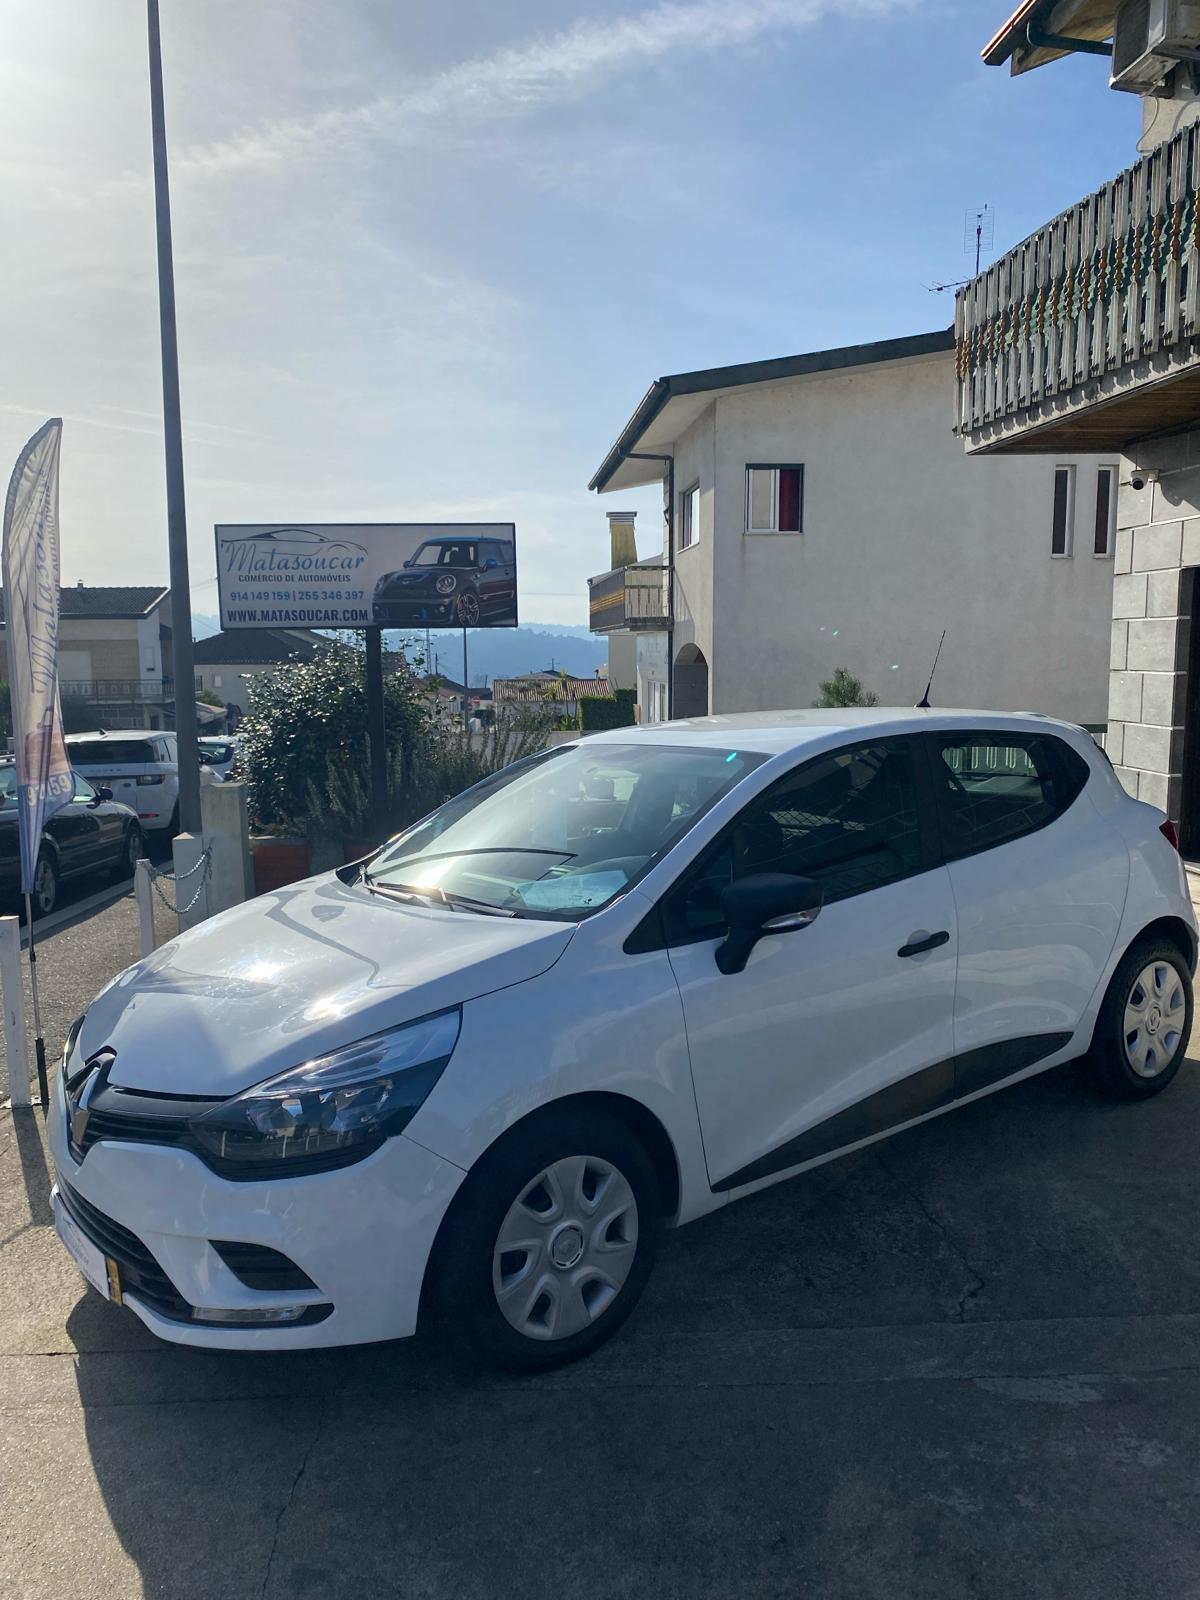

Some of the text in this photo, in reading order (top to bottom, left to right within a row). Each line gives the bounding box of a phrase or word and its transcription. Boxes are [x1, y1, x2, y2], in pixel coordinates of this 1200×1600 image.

[222, 543, 365, 574] Matasoucar
[31, 470, 58, 694] Matasou
[238, 573, 352, 583] COMÉRCIO DE AUTOMÓVEIS
[230, 591, 248, 601] 914
[251, 591, 270, 601] 149
[272, 591, 291, 601] 159
[298, 590, 319, 601] 255
[321, 590, 342, 601] 346
[345, 590, 364, 601] 397
[227, 609, 368, 622] WWW.MATASOUCAR.COM
